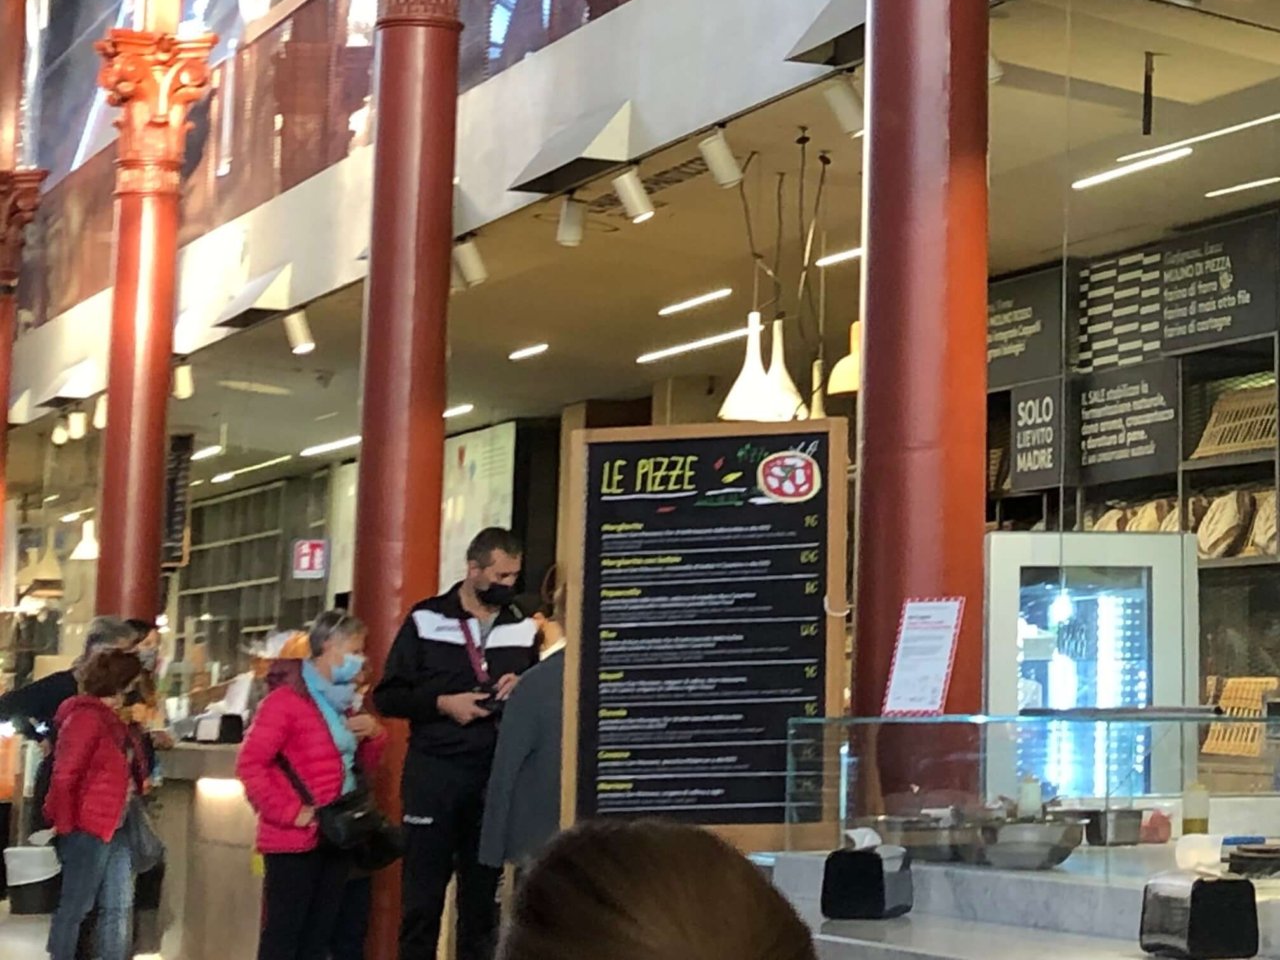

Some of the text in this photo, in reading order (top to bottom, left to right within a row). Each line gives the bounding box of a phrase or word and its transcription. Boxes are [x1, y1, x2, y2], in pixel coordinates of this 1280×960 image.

[1164, 264, 1194, 283] MOLINO
[1195, 261, 1204, 277] DI
[1088, 387, 1106, 404] SALE
[1017, 396, 1054, 428] SOLO
[1017, 427, 1054, 449] LIEVITO
[1017, 448, 1054, 473] MADRE
[600, 455, 699, 495] LE PIZZE
